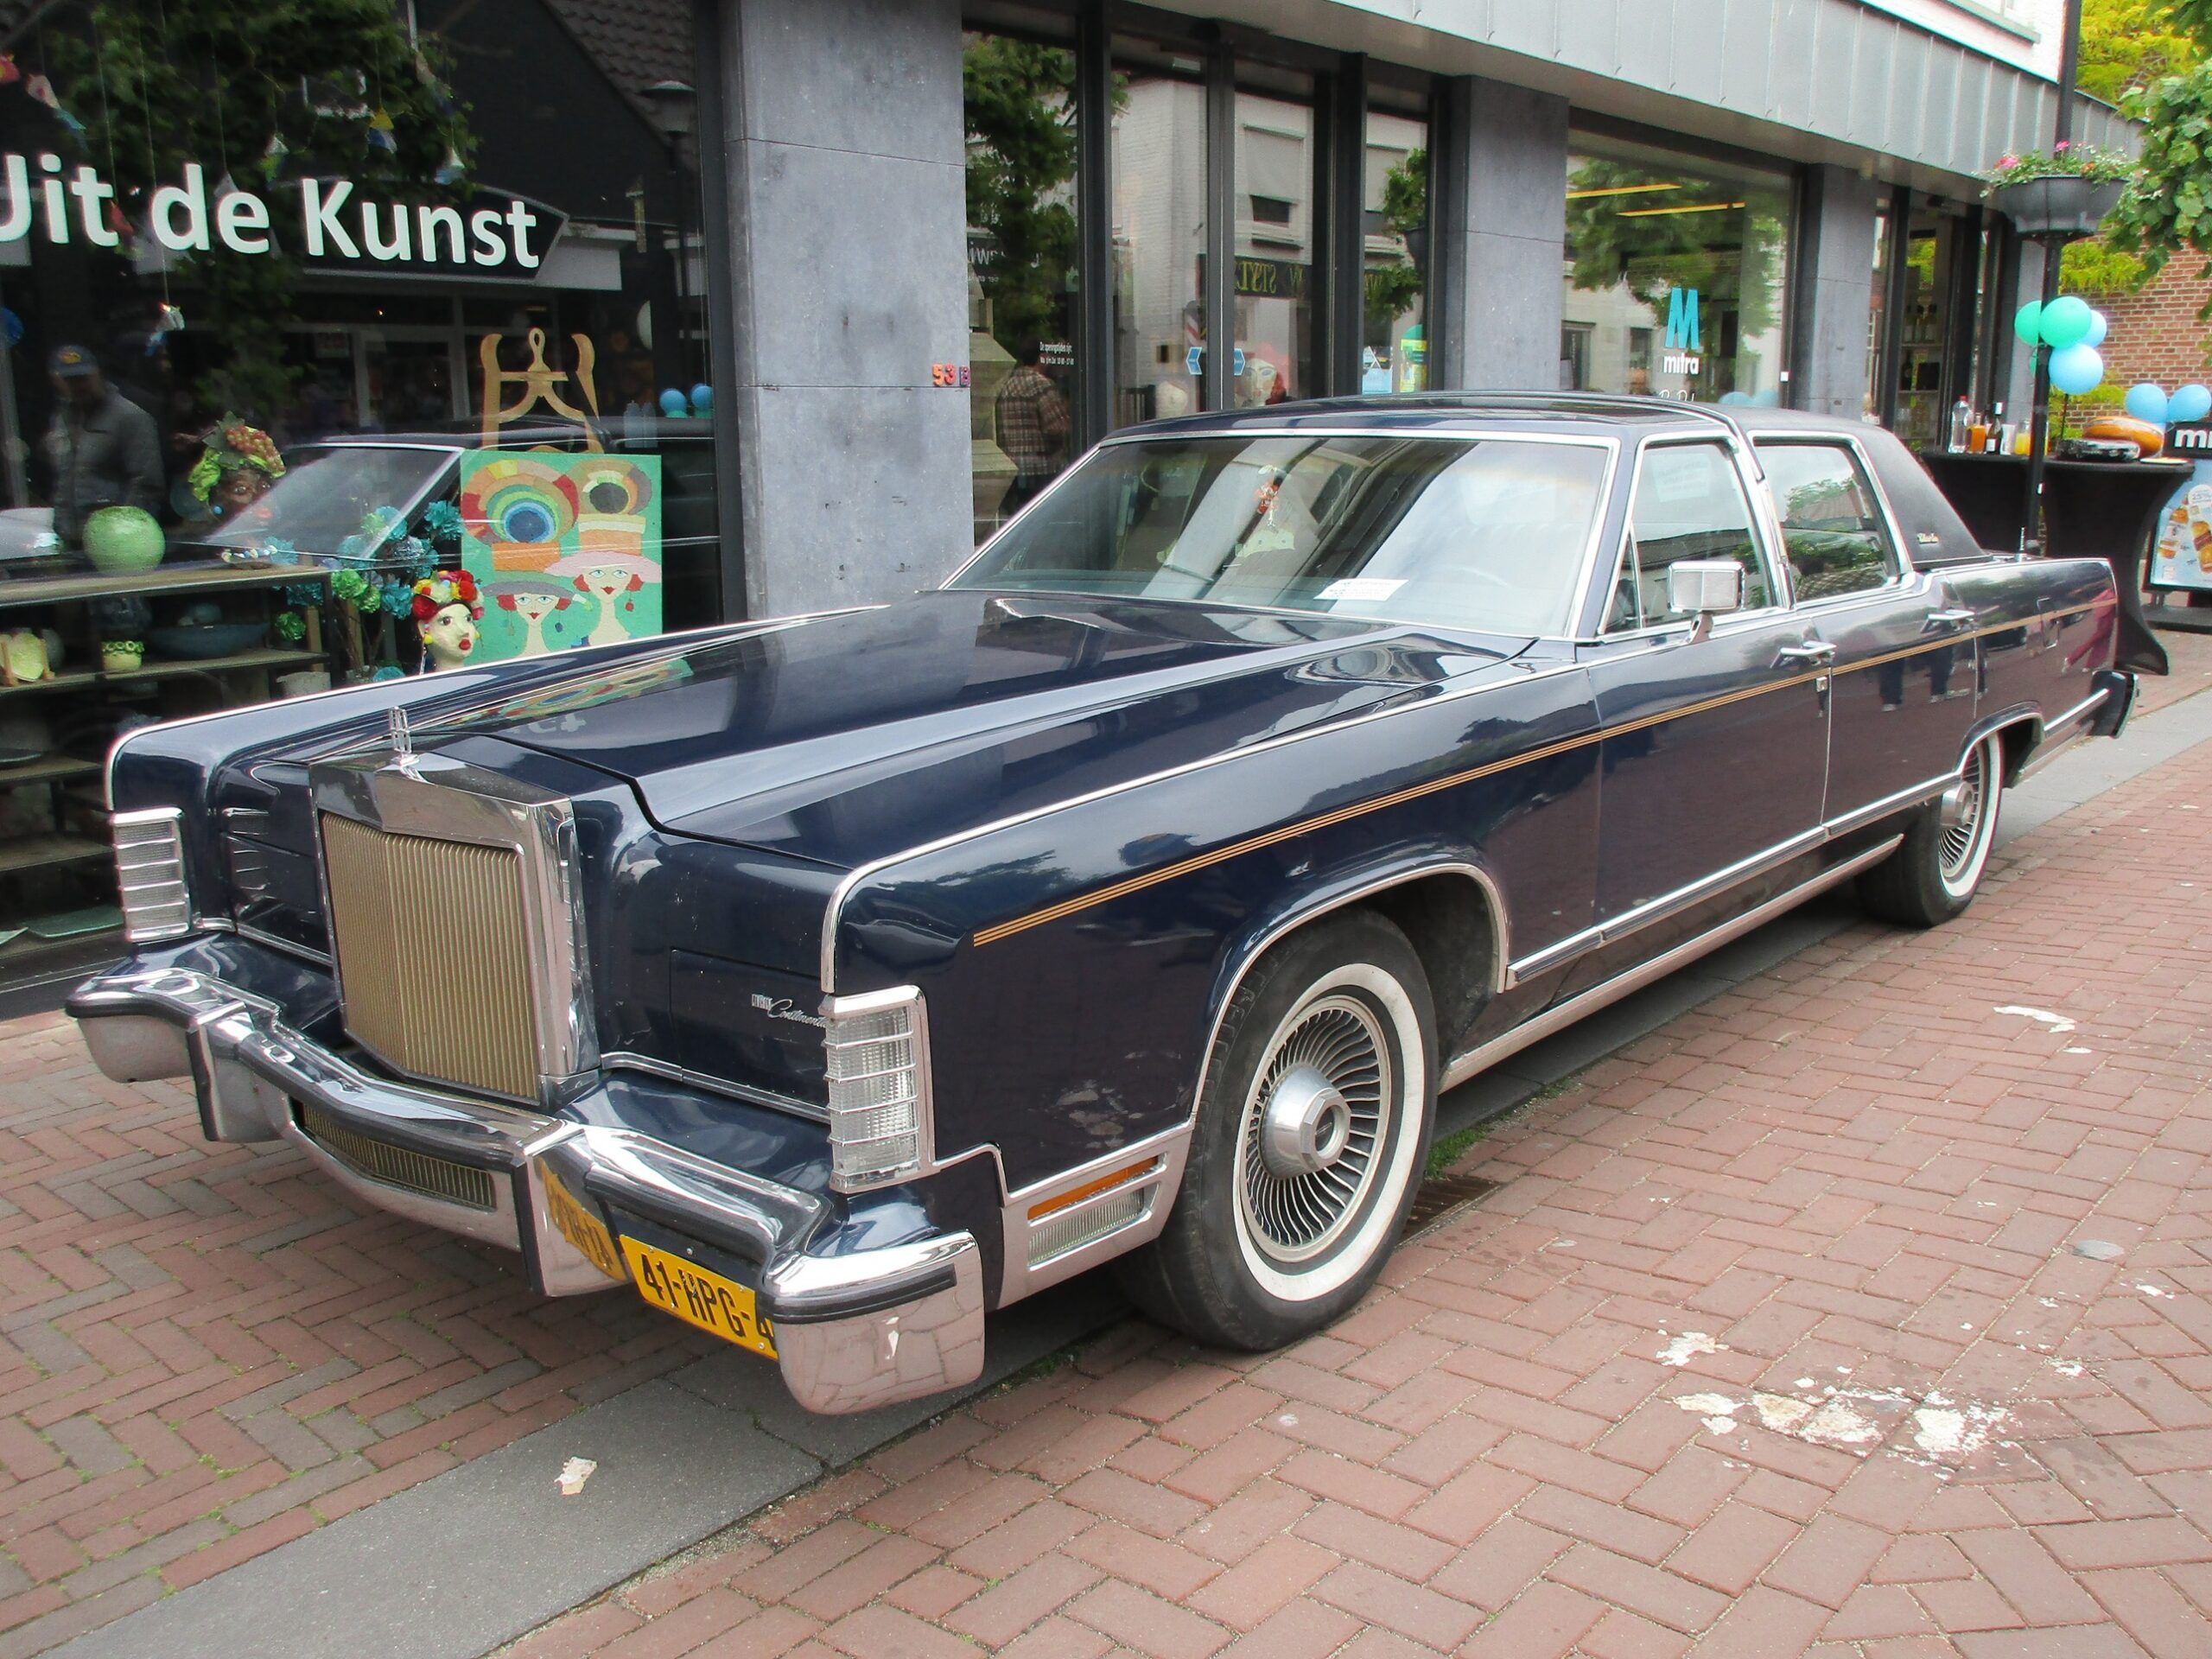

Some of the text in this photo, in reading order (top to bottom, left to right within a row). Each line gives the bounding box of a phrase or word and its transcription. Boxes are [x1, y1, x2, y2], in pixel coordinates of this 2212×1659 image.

[150, 162, 270, 255] de
[302, 178, 540, 269] Kunst
[1664, 287, 1700, 351] M
[932, 362, 957, 387] 53
[1663, 353, 1700, 375] mitra
